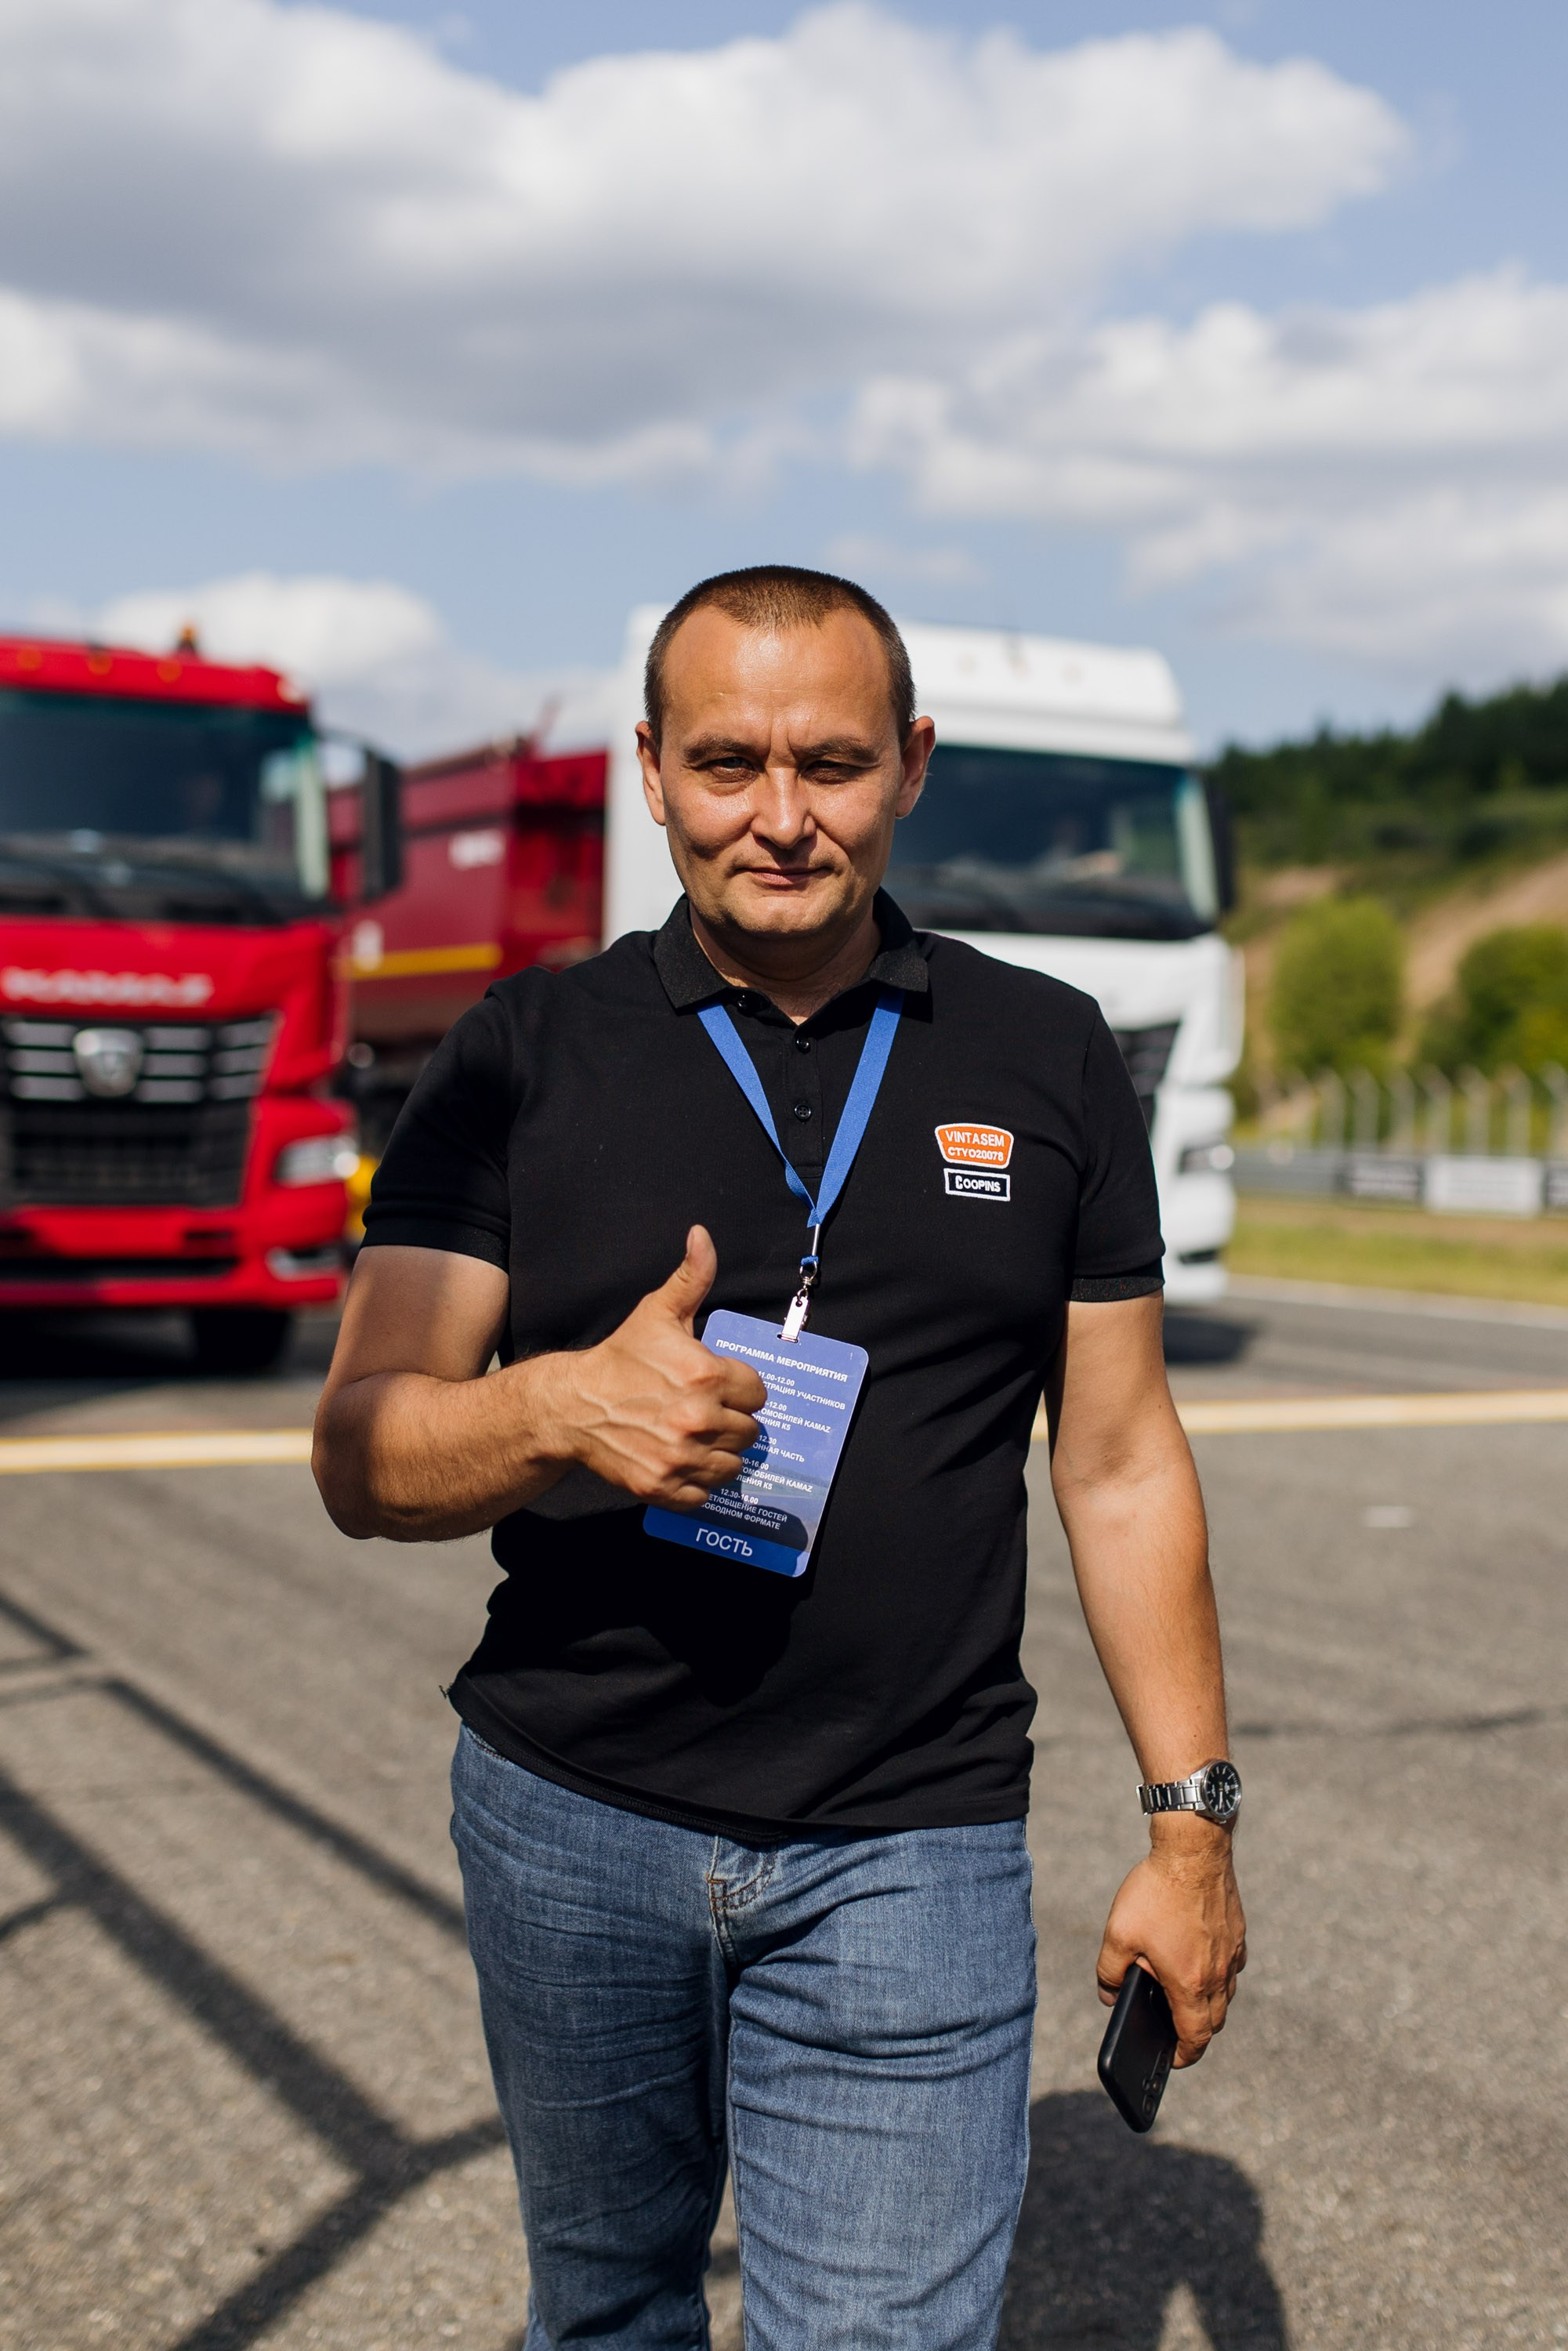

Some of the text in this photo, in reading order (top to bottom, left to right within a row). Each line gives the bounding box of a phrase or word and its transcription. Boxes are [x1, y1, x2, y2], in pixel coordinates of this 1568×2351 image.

[945, 1130, 1005, 1147] VINTASEM
[715, 1339, 848, 1382] ПРОГРАММА МЕРОПРИЯТИЯ
[758, 1371, 795, 1386] 11.00-12.00
[765, 1400, 788, 1411] -12.00
[797, 1390, 846, 1410] УЧАСТНИКОВ
[758, 1407, 831, 1433] ОМОБИЛЕЙ KAMAZ
[780, 1449, 805, 1462] ЧАСТЬ
[742, 1465, 813, 1493] ОМОБИЛЕЙ KAMAZ
[721, 1488, 759, 1505] 12.30-16.00
[702, 1502, 780, 1530] ОБОДНОМ ФОРМАТЕ
[758, 1509, 788, 1523] ГОСТЕЙ
[696, 1527, 753, 1557] ГОСТЬ
